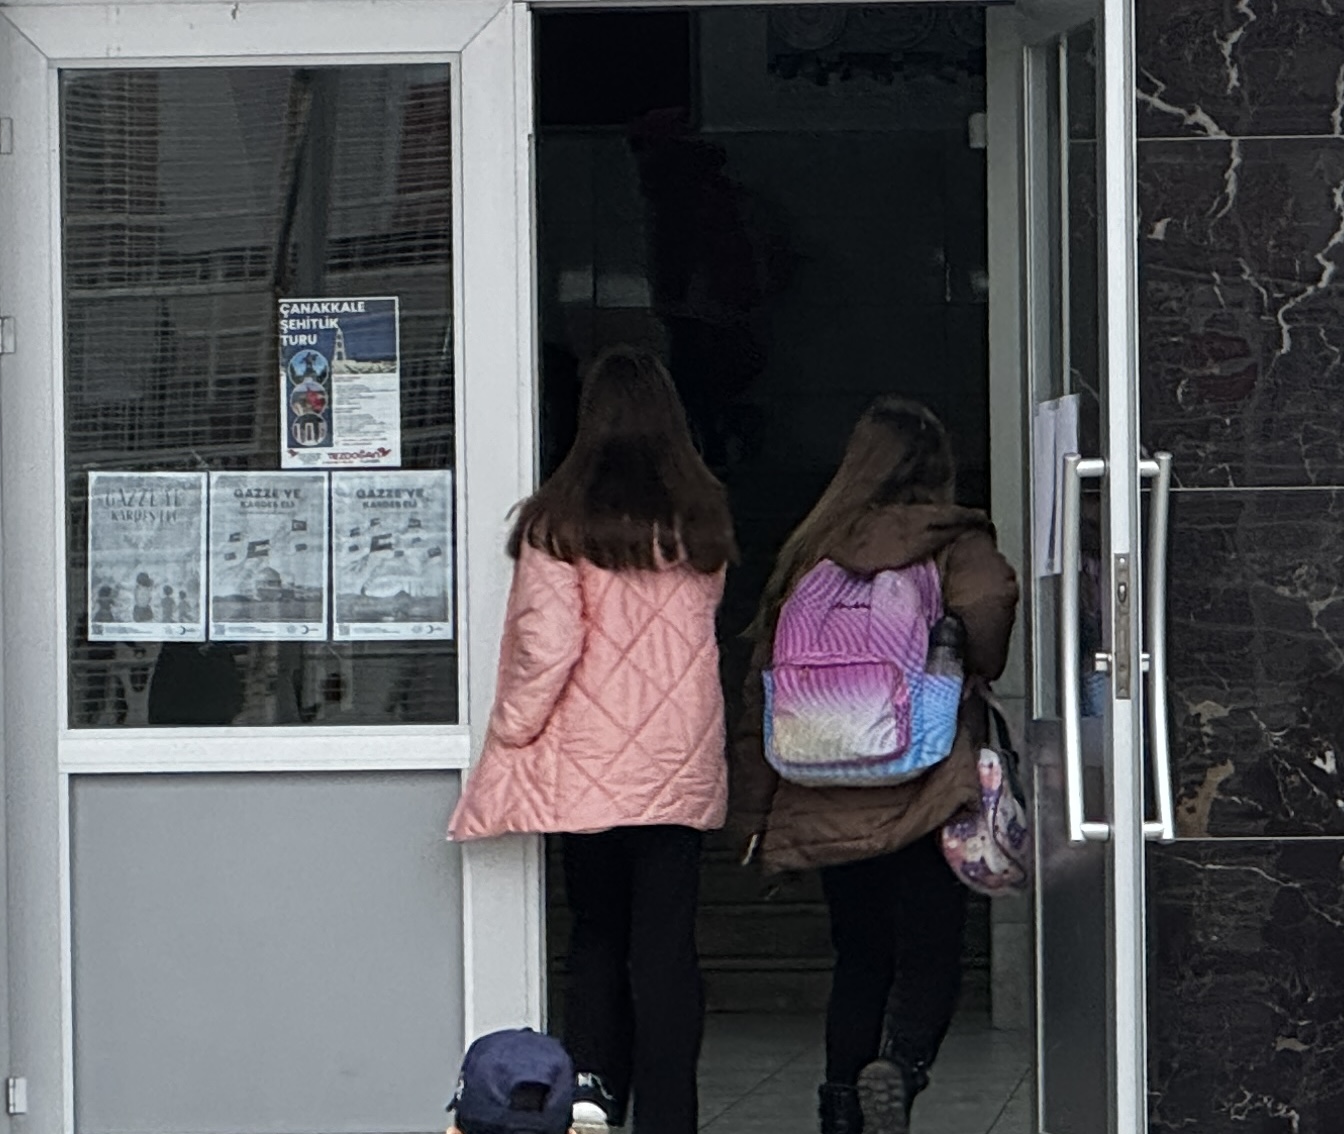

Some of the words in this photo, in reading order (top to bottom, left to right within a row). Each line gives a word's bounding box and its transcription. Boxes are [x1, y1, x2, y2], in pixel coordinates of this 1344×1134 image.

[279, 301, 366, 318] ÇANAKKALE
[279, 315, 340, 334] ŞEHİTLİK
[281, 334, 318, 346] TURU
